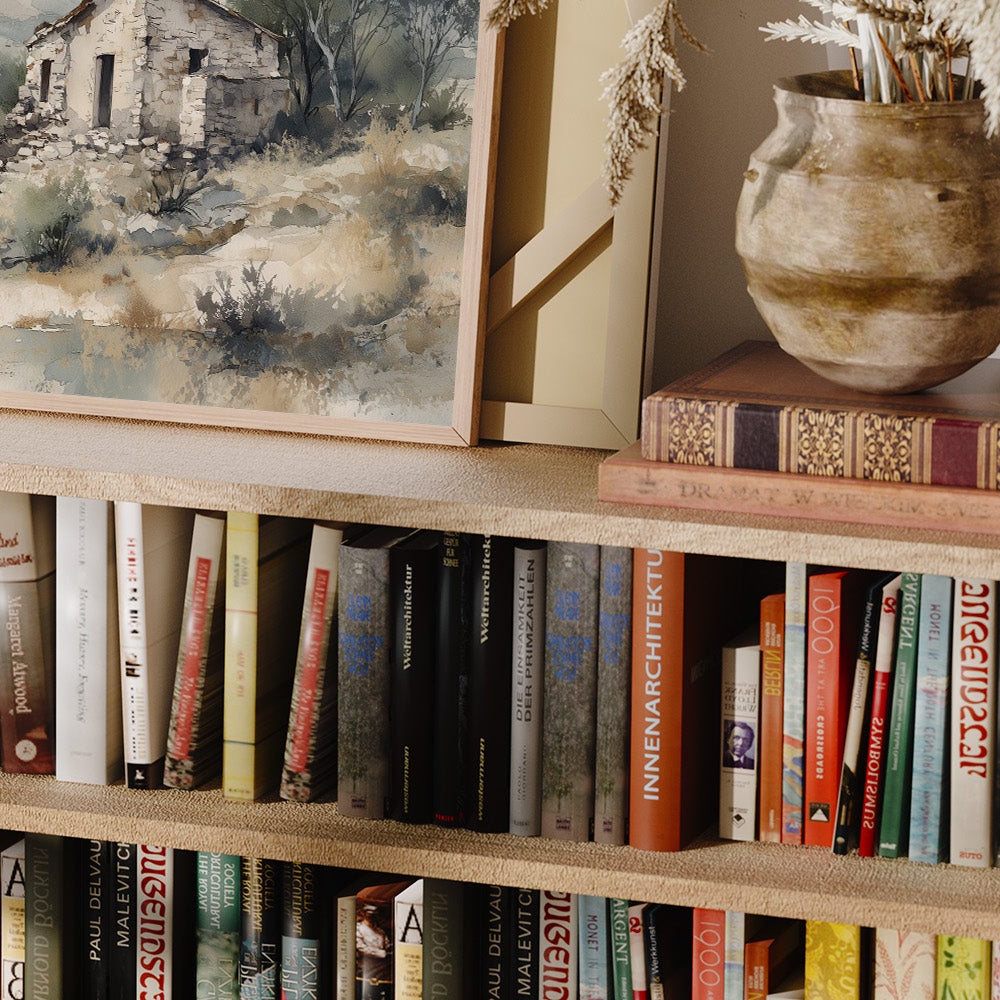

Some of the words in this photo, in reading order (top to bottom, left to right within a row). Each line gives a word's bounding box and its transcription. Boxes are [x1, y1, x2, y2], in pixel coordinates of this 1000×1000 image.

[6, 595, 25, 657] Margaret
[403, 564, 413, 671] Weltarchitektur
[516, 576, 526, 689] EINSAMKEIT
[525, 558, 535, 682] PRIMZAHLEN
[13, 657, 32, 714] Atwood
[515, 692, 524, 722] DIE
[524, 690, 532, 723] DER
[643, 548, 663, 801] INNENARCHITEKTU
[90, 840, 101, 910] DELVAU
[90, 916, 101, 961] PAUL
[489, 885, 502, 957] DELVAU
[587, 914, 598, 951] MONET
[613, 899, 629, 966] ARGENT
[651, 925, 659, 975] Werkkunst
[693, 921, 721, 987] 1900
